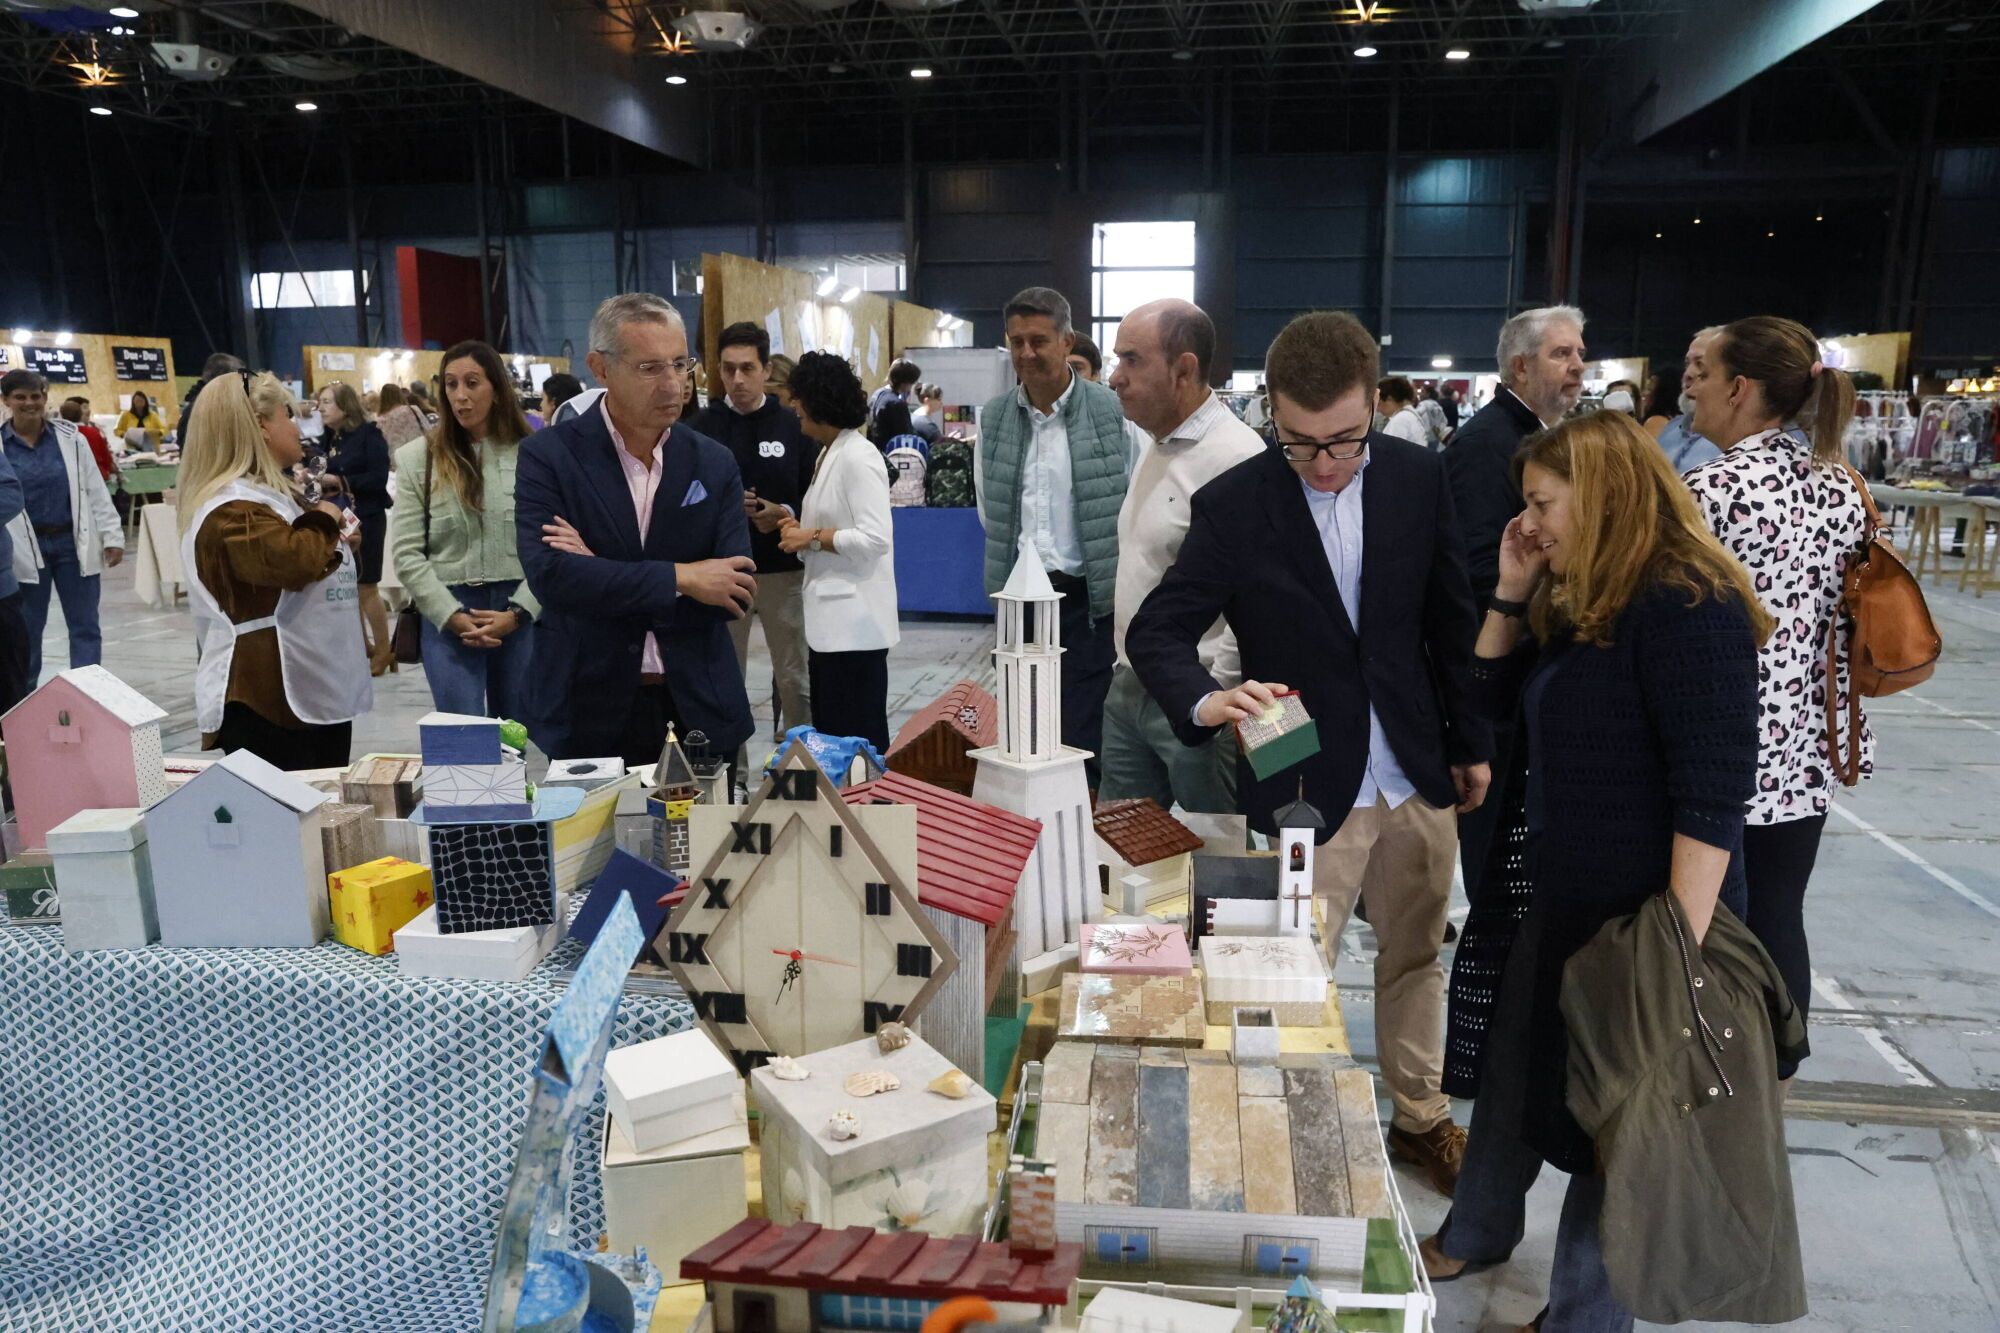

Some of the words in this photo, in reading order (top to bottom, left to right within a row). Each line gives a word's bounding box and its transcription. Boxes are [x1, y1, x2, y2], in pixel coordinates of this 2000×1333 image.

[765, 769, 818, 801] XII
[730, 821, 772, 855] XI
[702, 878, 731, 909] X
[865, 882, 891, 916] II
[669, 932, 710, 965] IX
[897, 943, 932, 978] III
